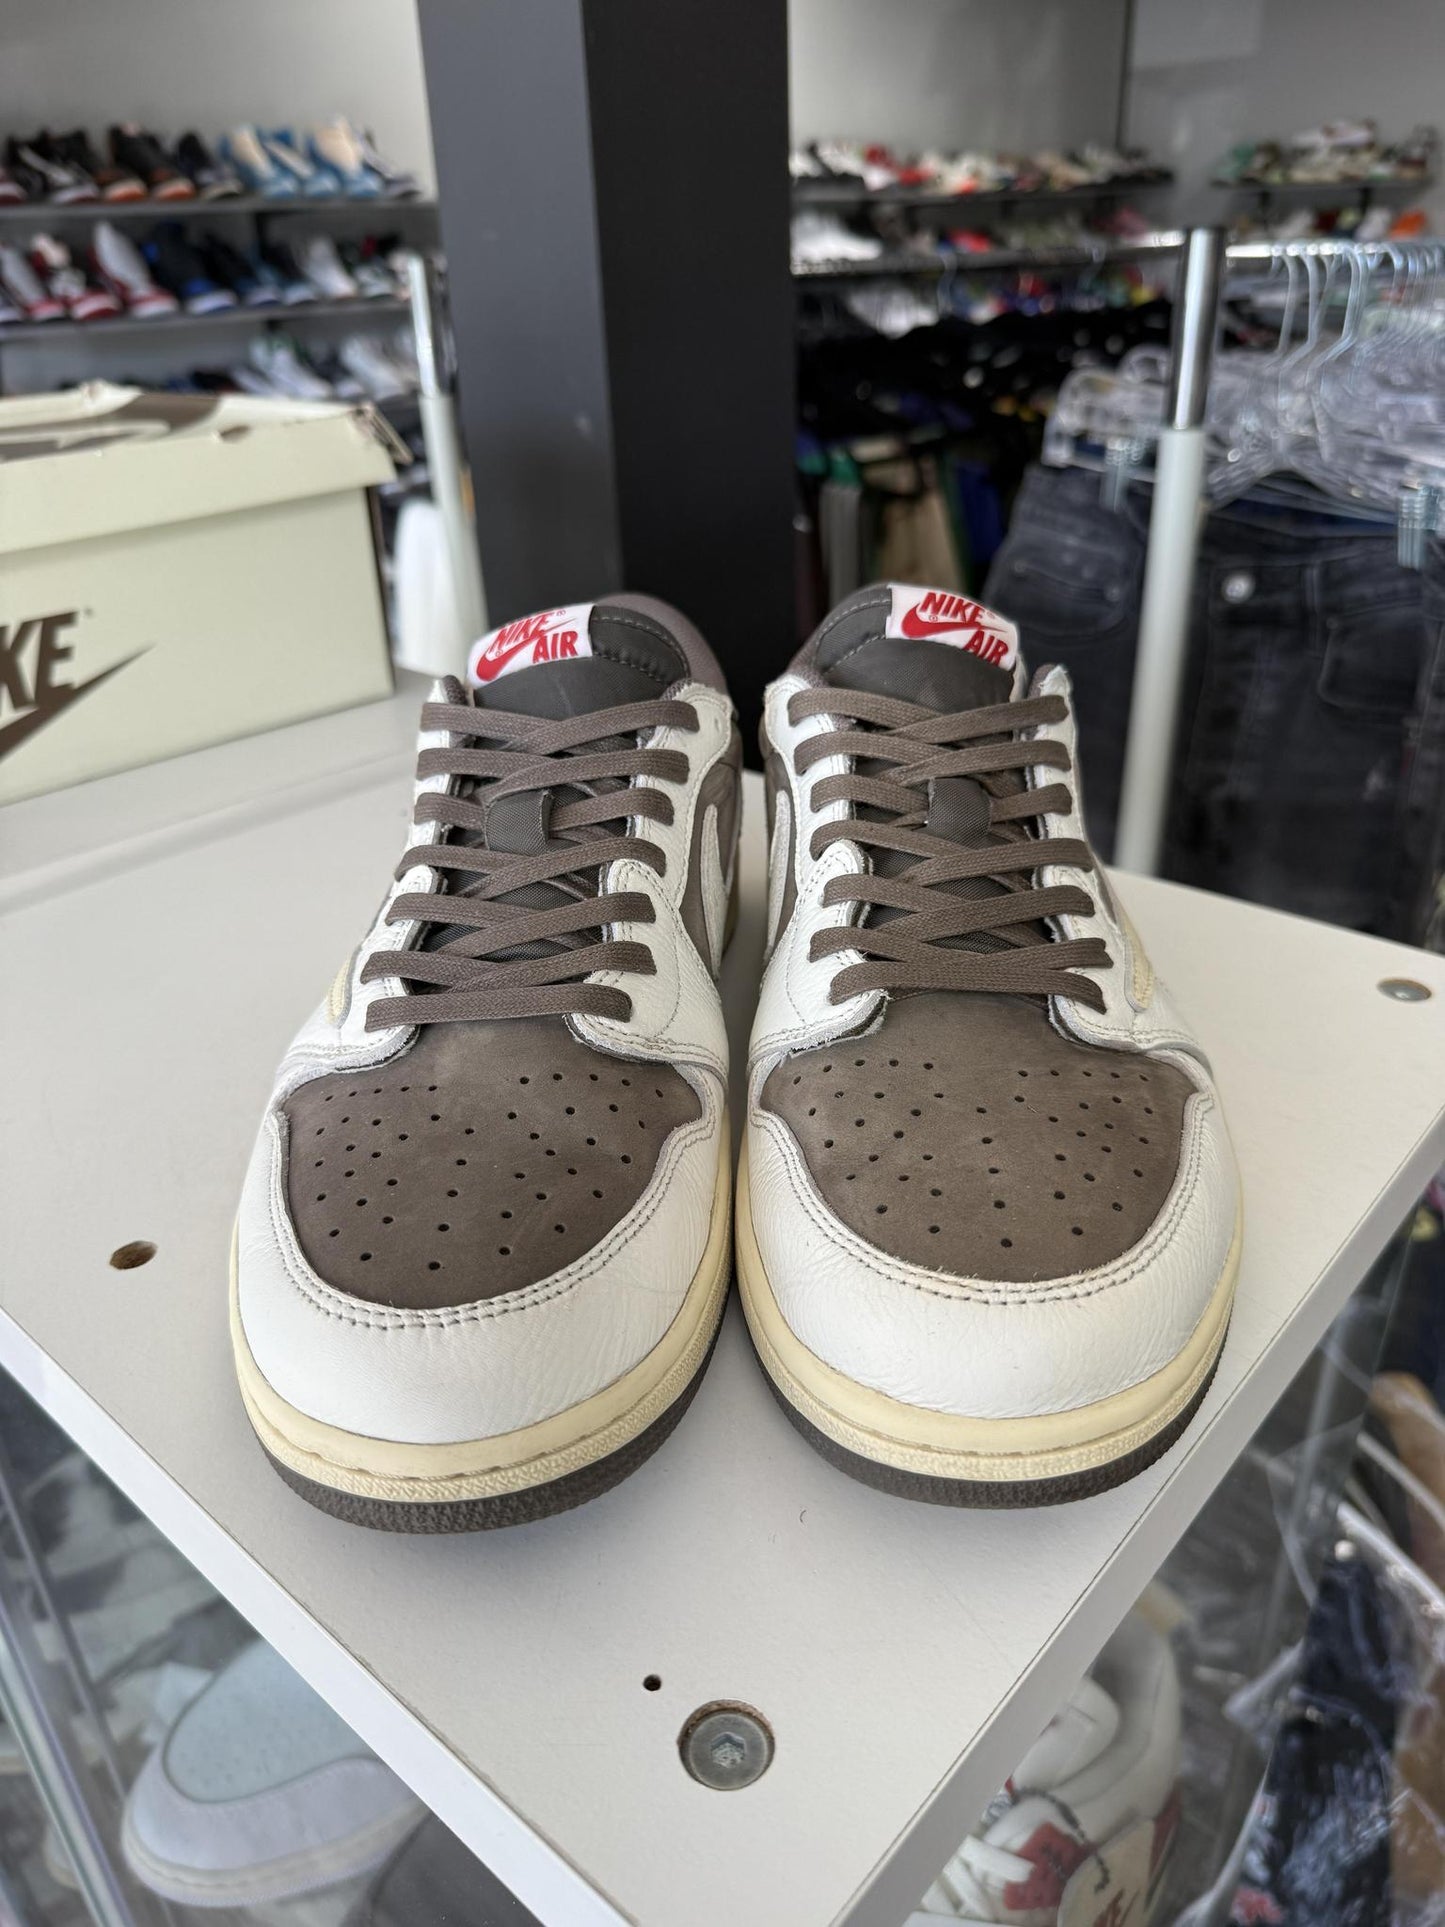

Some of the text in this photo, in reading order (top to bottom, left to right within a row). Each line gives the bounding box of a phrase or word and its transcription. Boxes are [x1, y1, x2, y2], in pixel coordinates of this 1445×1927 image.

[919, 592, 986, 624] NIKE
[488, 609, 555, 654] NIKE
[532, 630, 578, 664] AIR
[963, 630, 1009, 666] AIR
